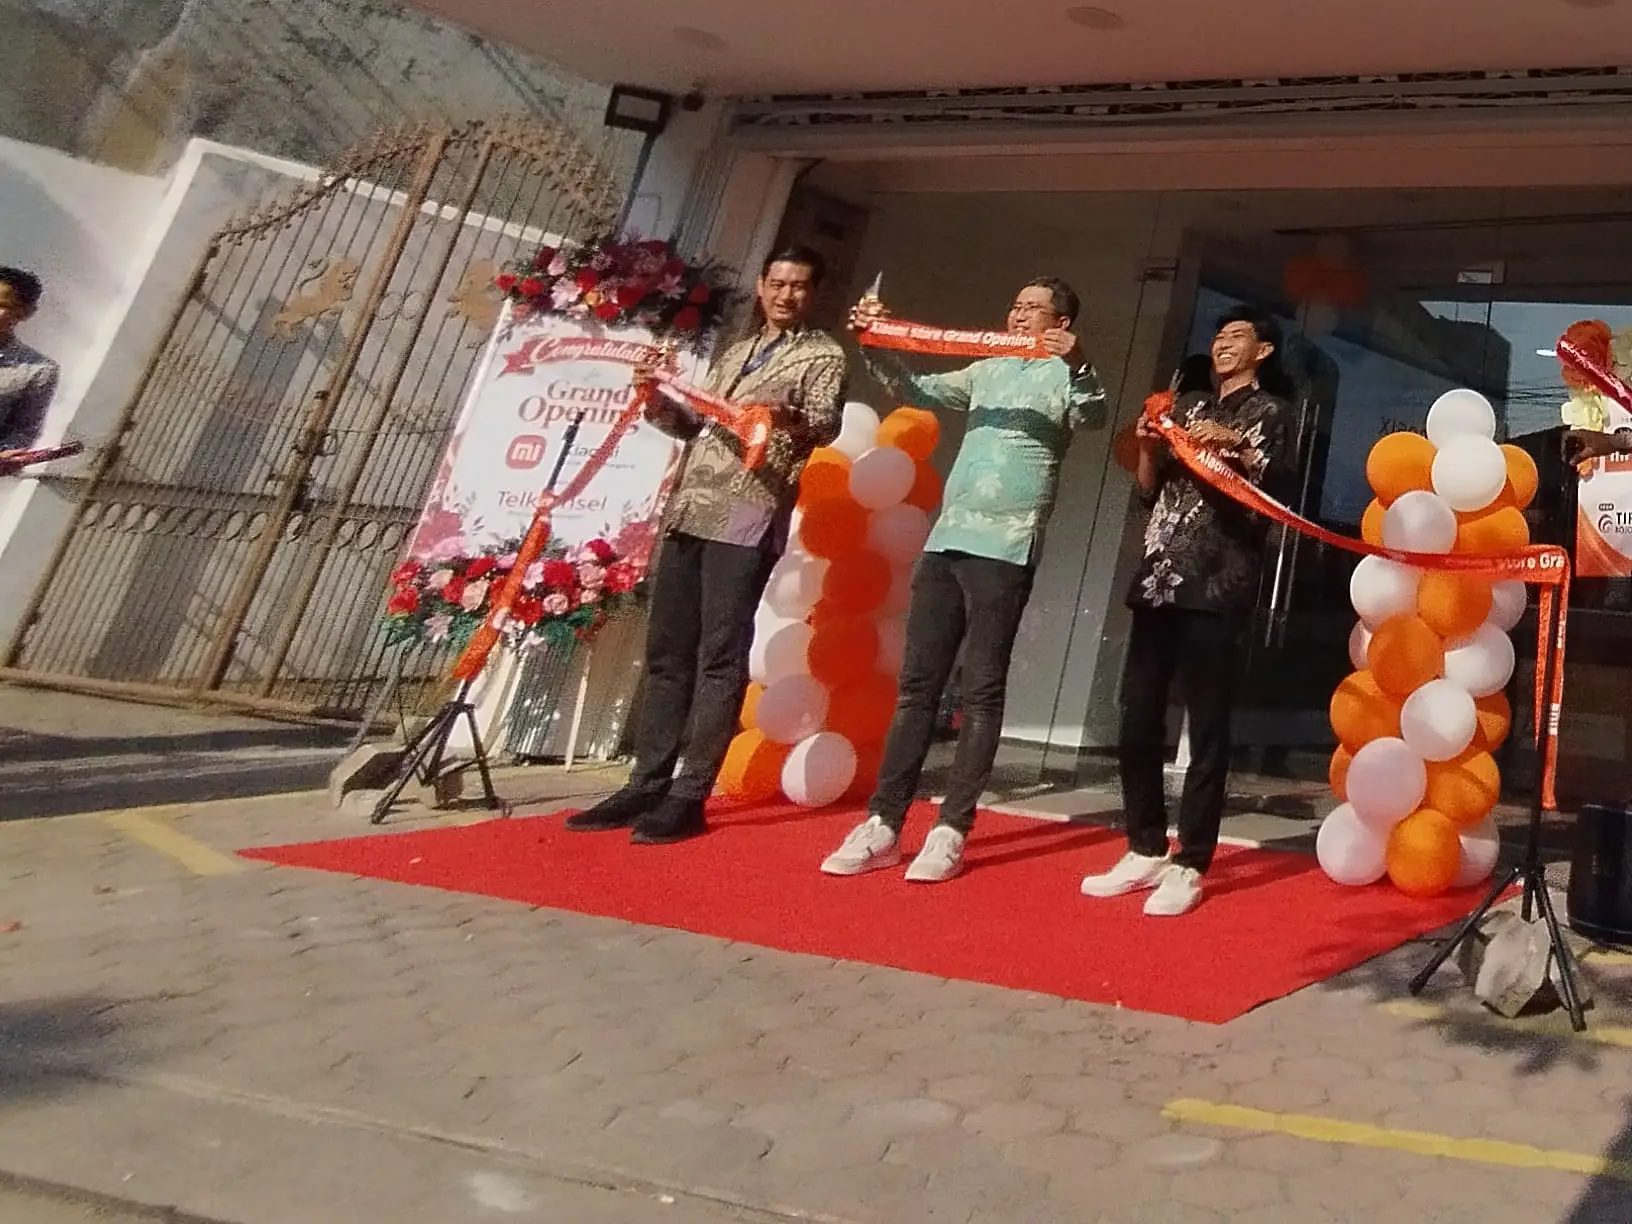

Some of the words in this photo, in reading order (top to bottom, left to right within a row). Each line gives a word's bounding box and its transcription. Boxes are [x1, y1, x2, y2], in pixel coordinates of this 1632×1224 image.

[530, 336, 648, 364] Congratulati
[943, 330, 983, 344] Grand
[983, 332, 1036, 350] Opening
[546, 378, 632, 407] Grand
[518, 394, 640, 436] Openin
[497, 490, 608, 511] Telksel
